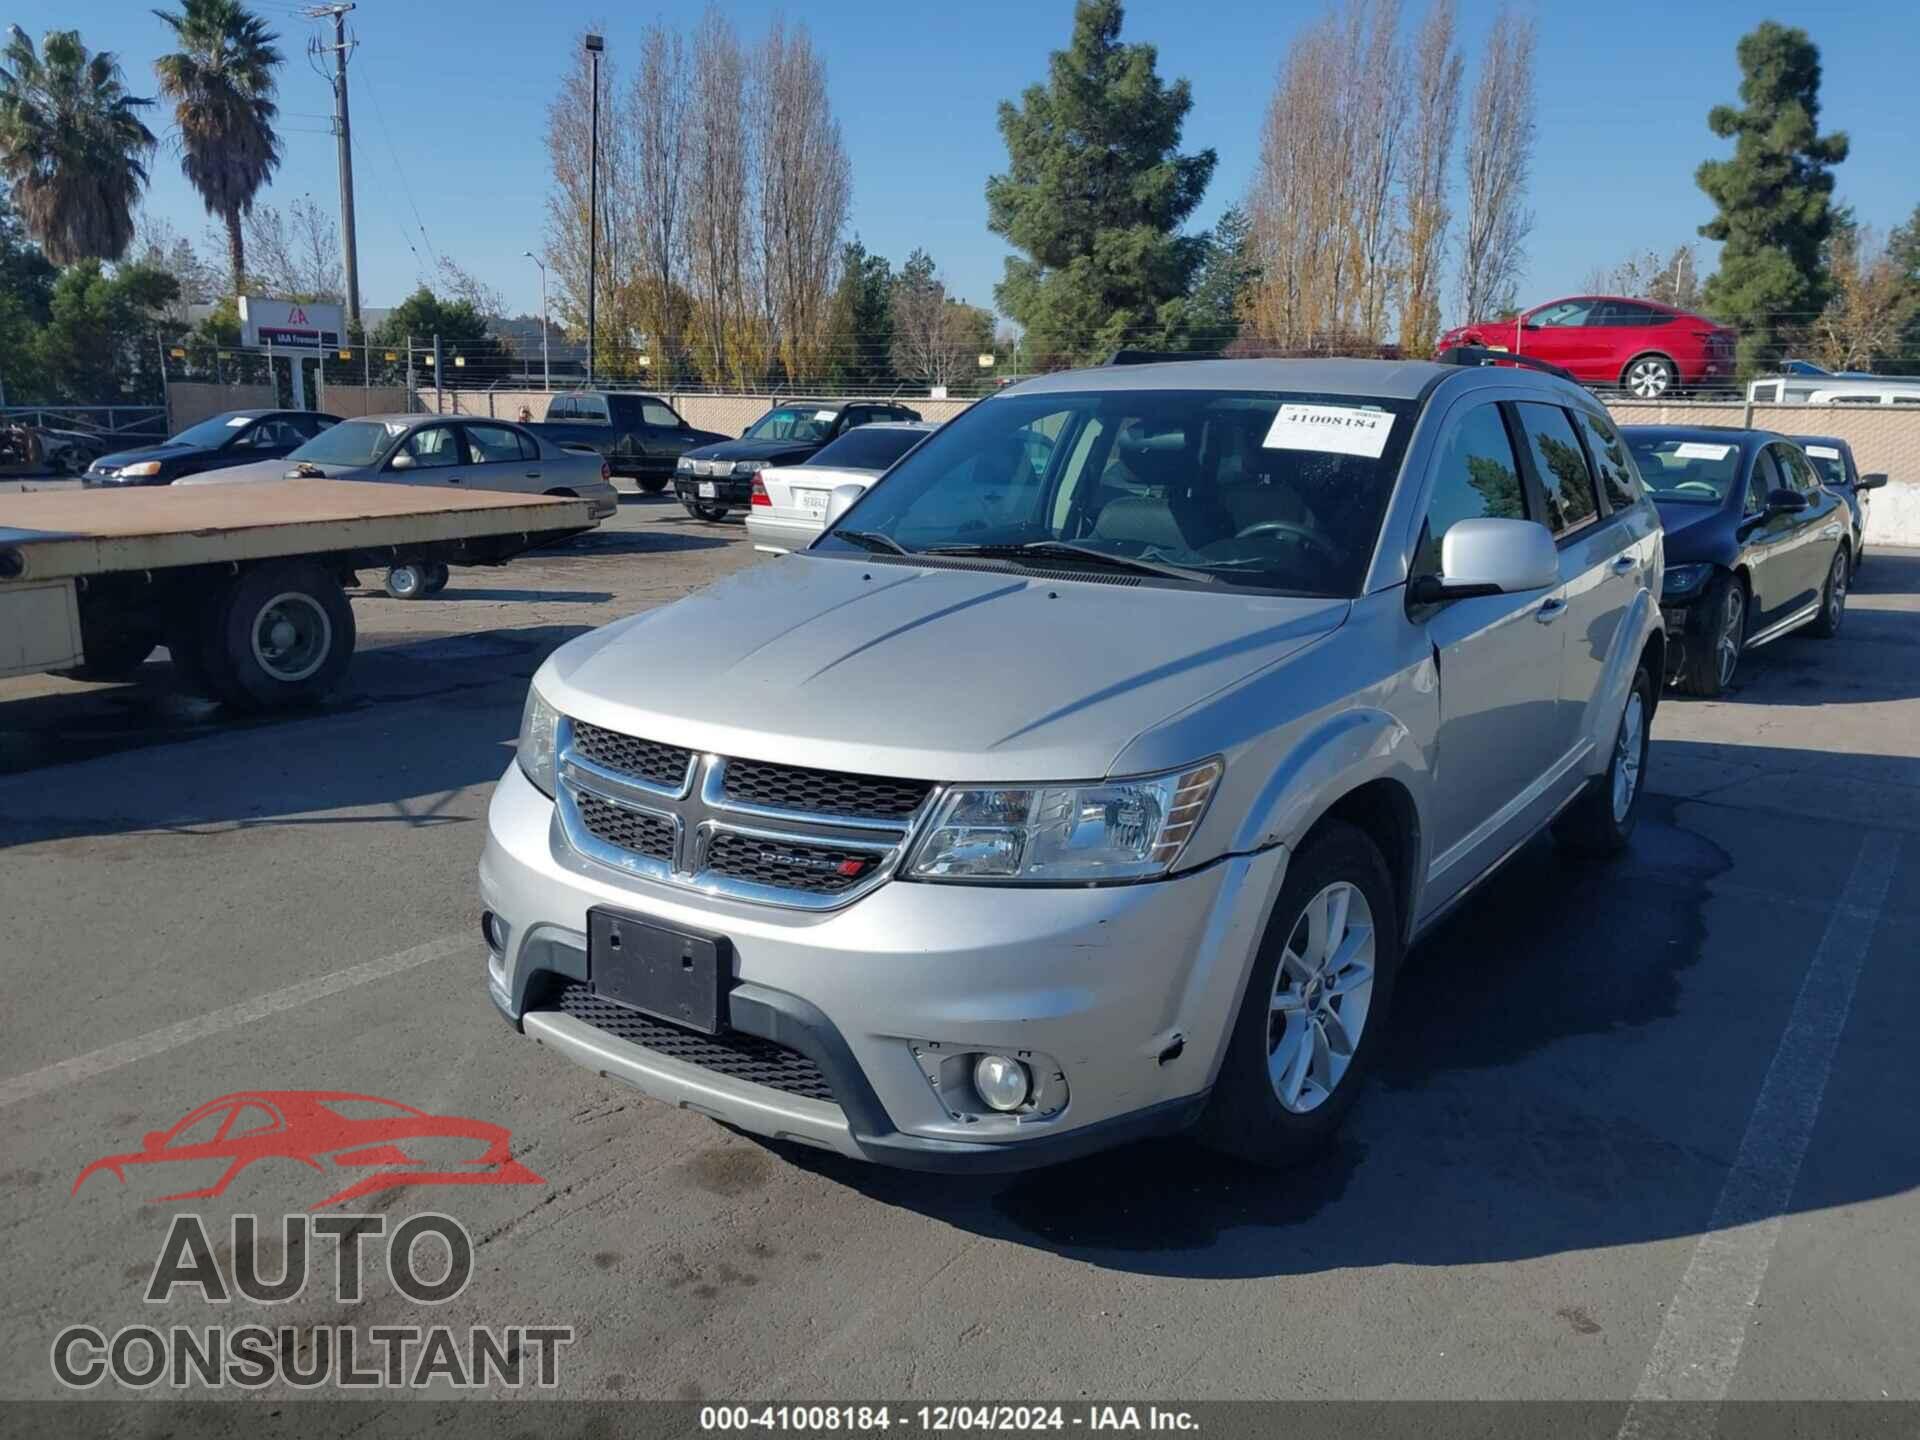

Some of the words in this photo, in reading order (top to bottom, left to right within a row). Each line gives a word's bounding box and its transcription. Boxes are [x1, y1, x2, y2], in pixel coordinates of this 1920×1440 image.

[277, 334, 291, 343] IAA
[1288, 414, 1376, 429] 41008184
[760, 852, 839, 868] DODGE
